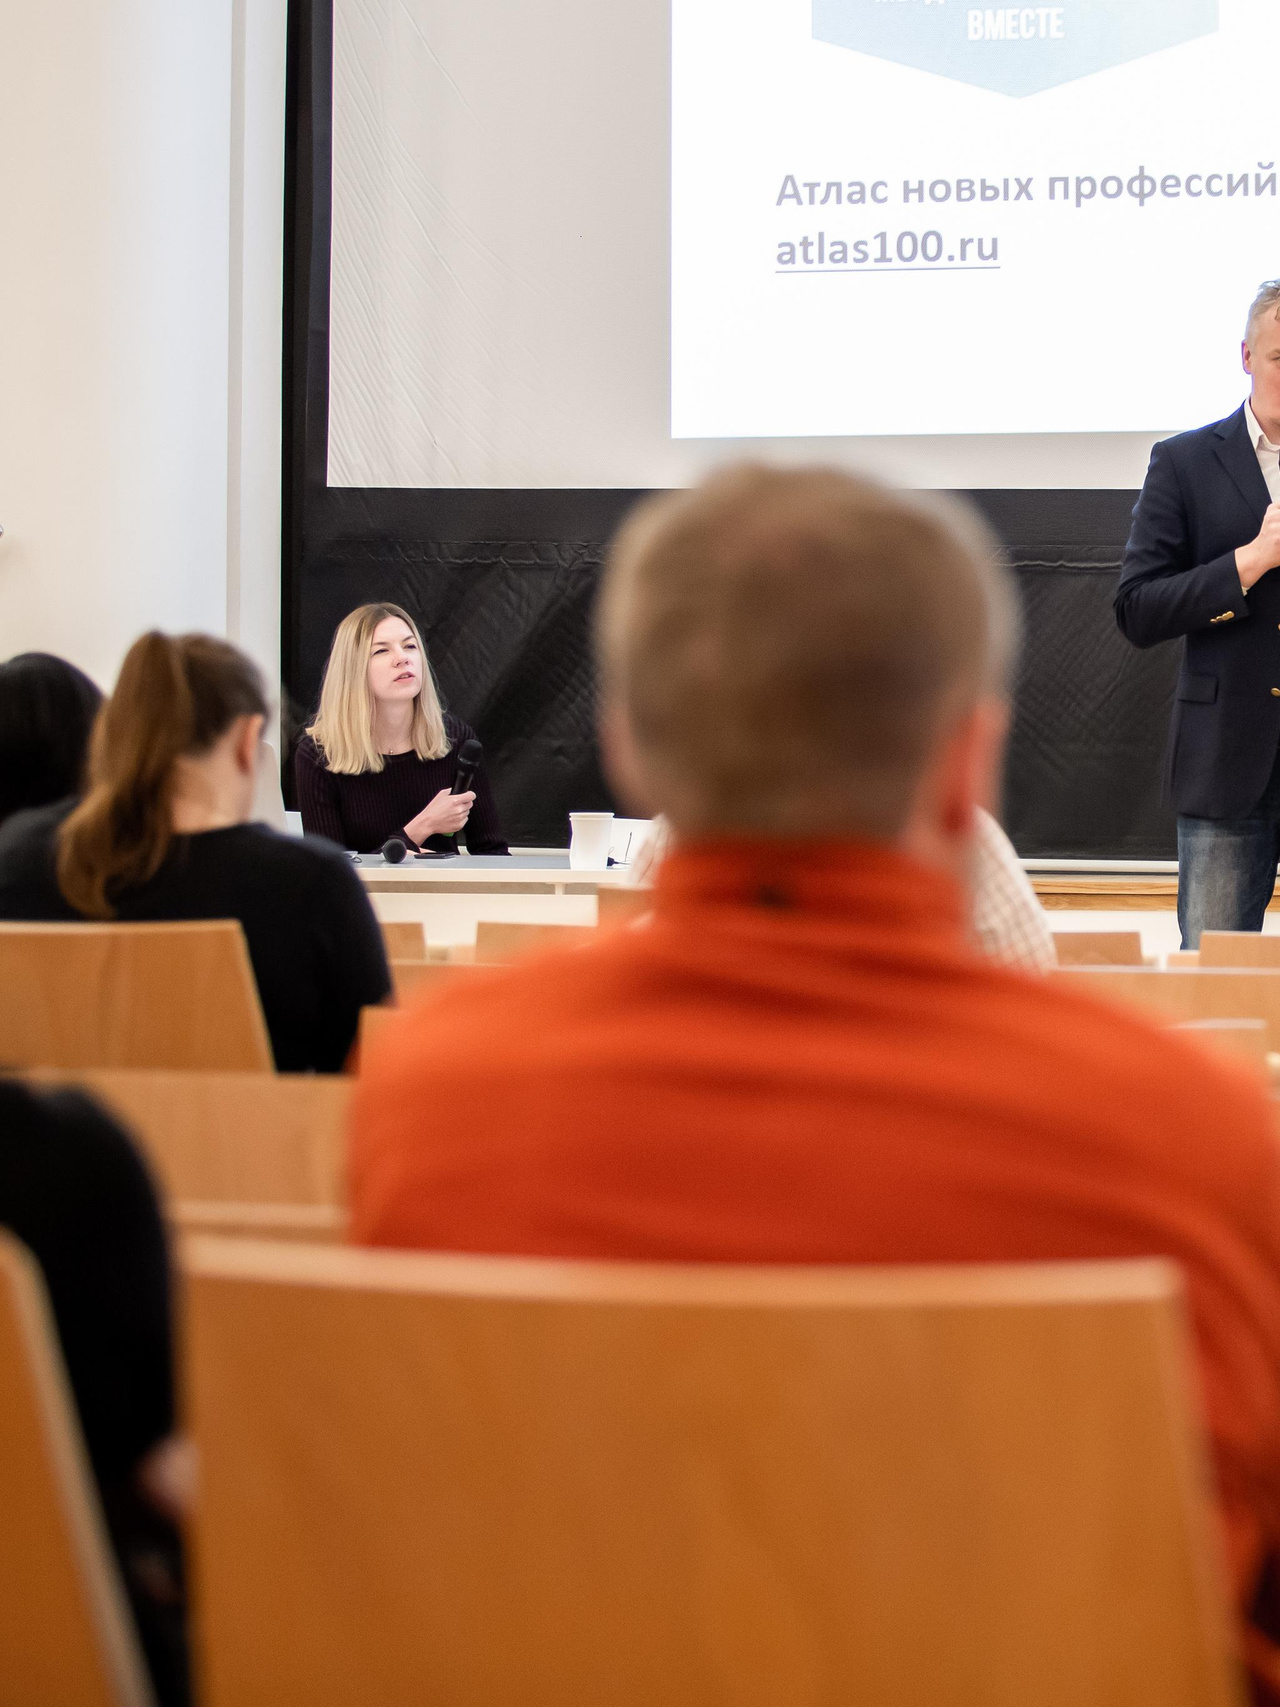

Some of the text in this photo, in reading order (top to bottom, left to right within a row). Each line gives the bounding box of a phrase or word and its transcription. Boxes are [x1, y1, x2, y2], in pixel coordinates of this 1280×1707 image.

[967, 7, 1066, 41] ВМЕСТЕ
[775, 161, 1278, 208] Атлас новых профессий
[775, 229, 1001, 269] atlas100.ru
